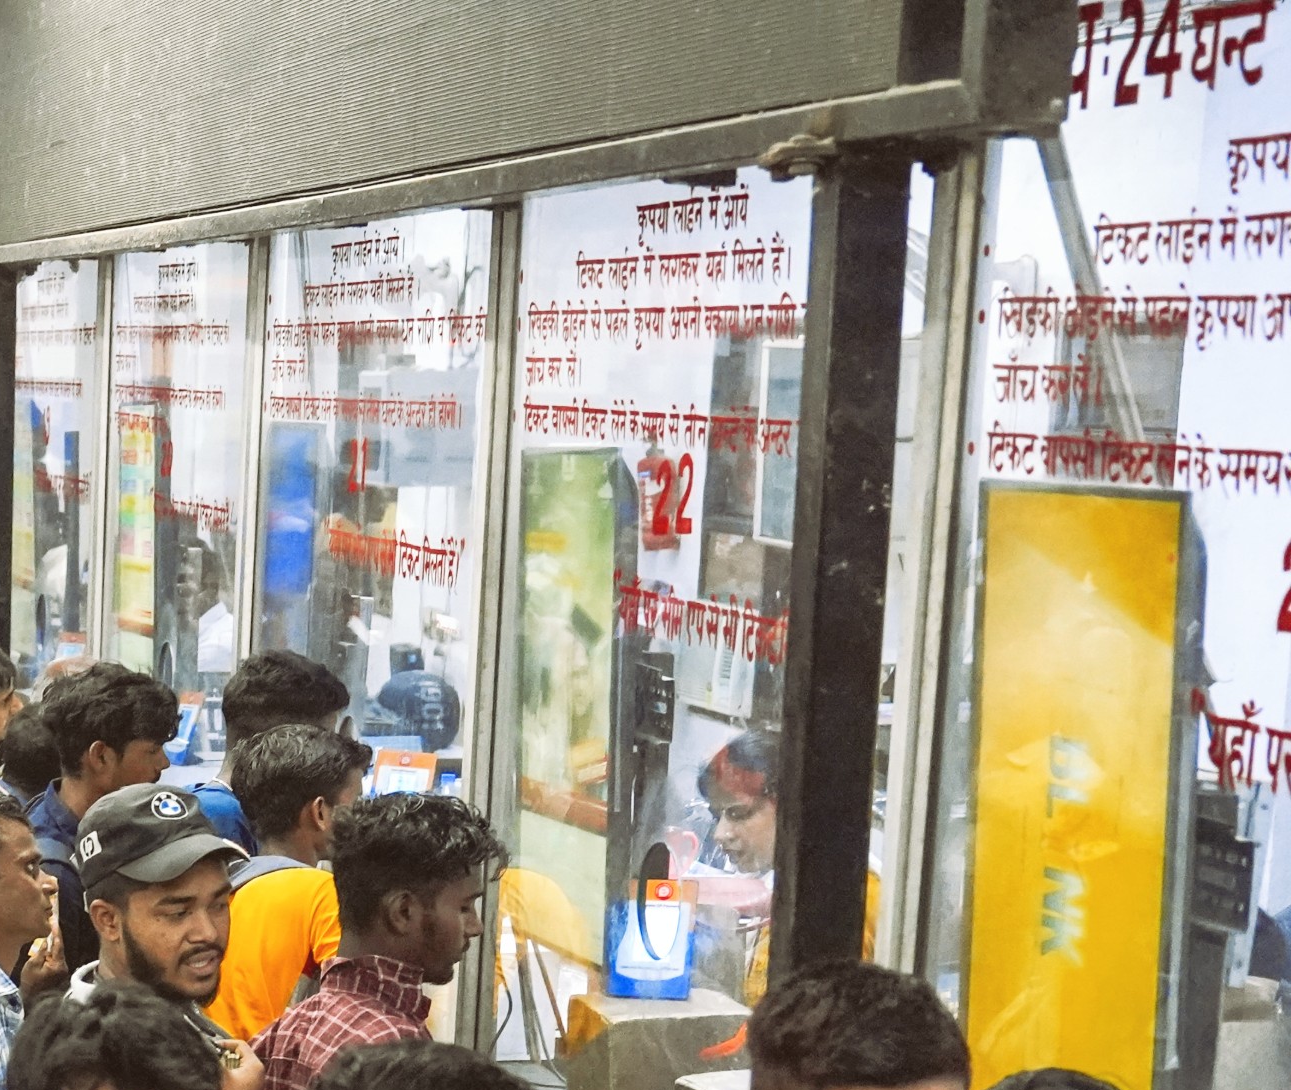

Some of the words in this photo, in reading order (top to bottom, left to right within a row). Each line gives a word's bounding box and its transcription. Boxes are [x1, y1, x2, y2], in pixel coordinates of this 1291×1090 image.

[1114, 0, 1182, 107] 24
[637, 200, 671, 247] कृपया
[1094, 213, 1152, 264] टिकट
[1156, 206, 1214, 265] लाईन
[1220, 205, 1239, 260] में
[576, 251, 605, 289] टिकट
[608, 247, 639, 291] लाईन
[644, 246, 655, 285] में
[659, 253, 701, 287] लगकर
[731, 238, 766, 284] मिलते
[604, 299, 630, 343] पहले
[634, 307, 666, 350] कृपया
[670, 296, 702, 340] अपनी
[1195, 295, 1257, 351] कृपया
[523, 394, 550, 434] टिकट
[551, 397, 579, 437] वापसी
[581, 398, 608, 440] टिकट
[683, 402, 708, 449] तीन
[987, 420, 1039, 474] टिकट
[1218, 448, 1283, 495] समय
[652, 452, 694, 536] 22
